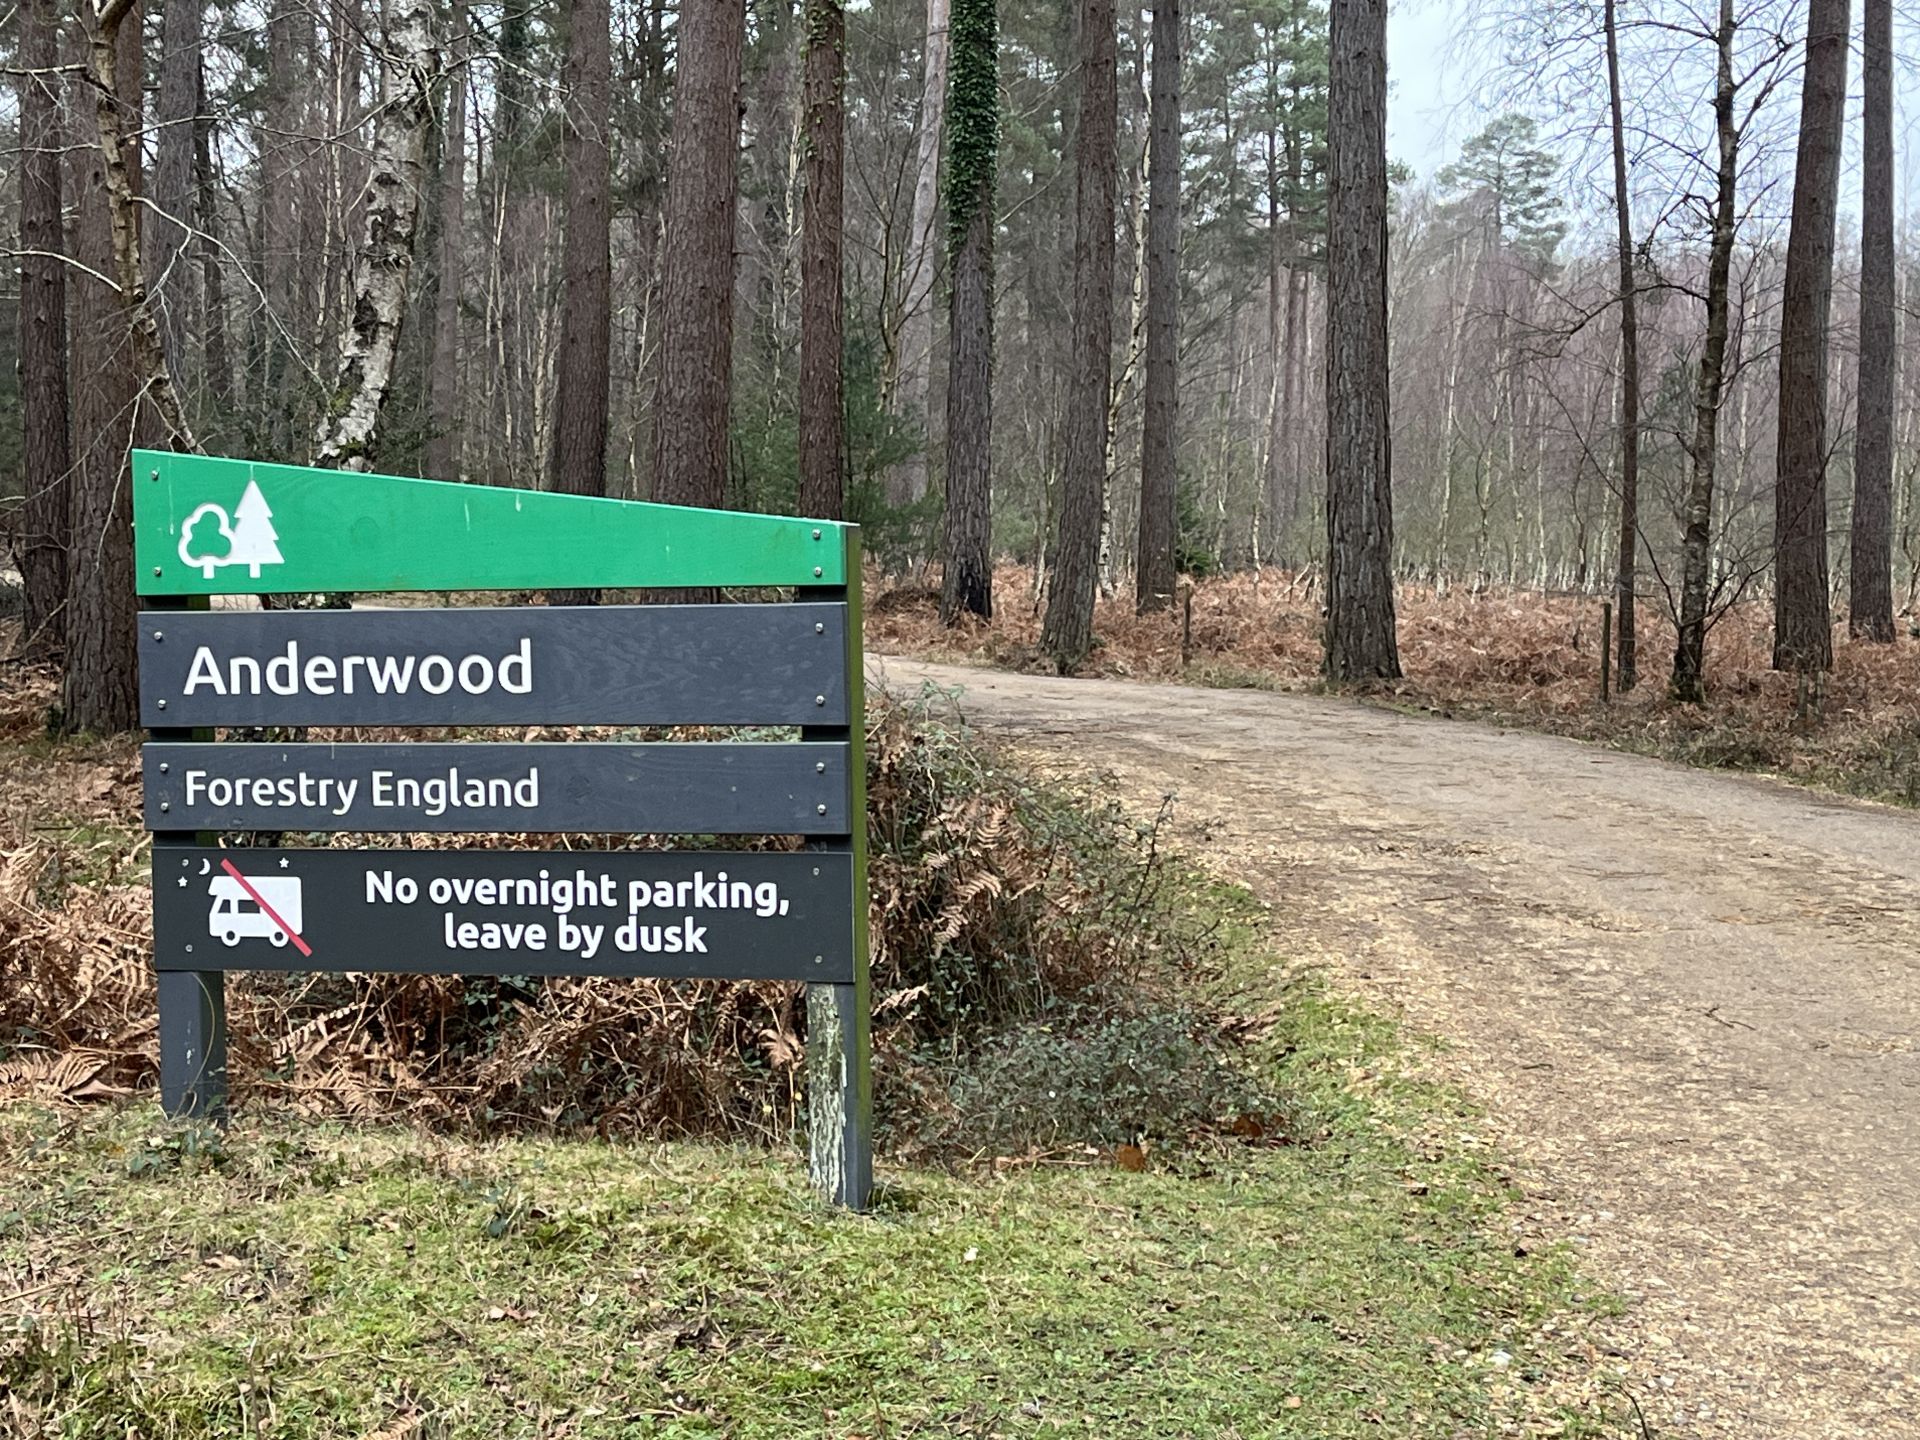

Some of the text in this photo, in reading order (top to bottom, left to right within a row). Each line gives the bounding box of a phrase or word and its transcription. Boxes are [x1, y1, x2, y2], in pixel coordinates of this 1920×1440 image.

[183, 637, 534, 696] Anderwood
[185, 767, 540, 817] Forestry England
[365, 868, 791, 916] No overnight parking,
[444, 912, 709, 959] leave by dusk
